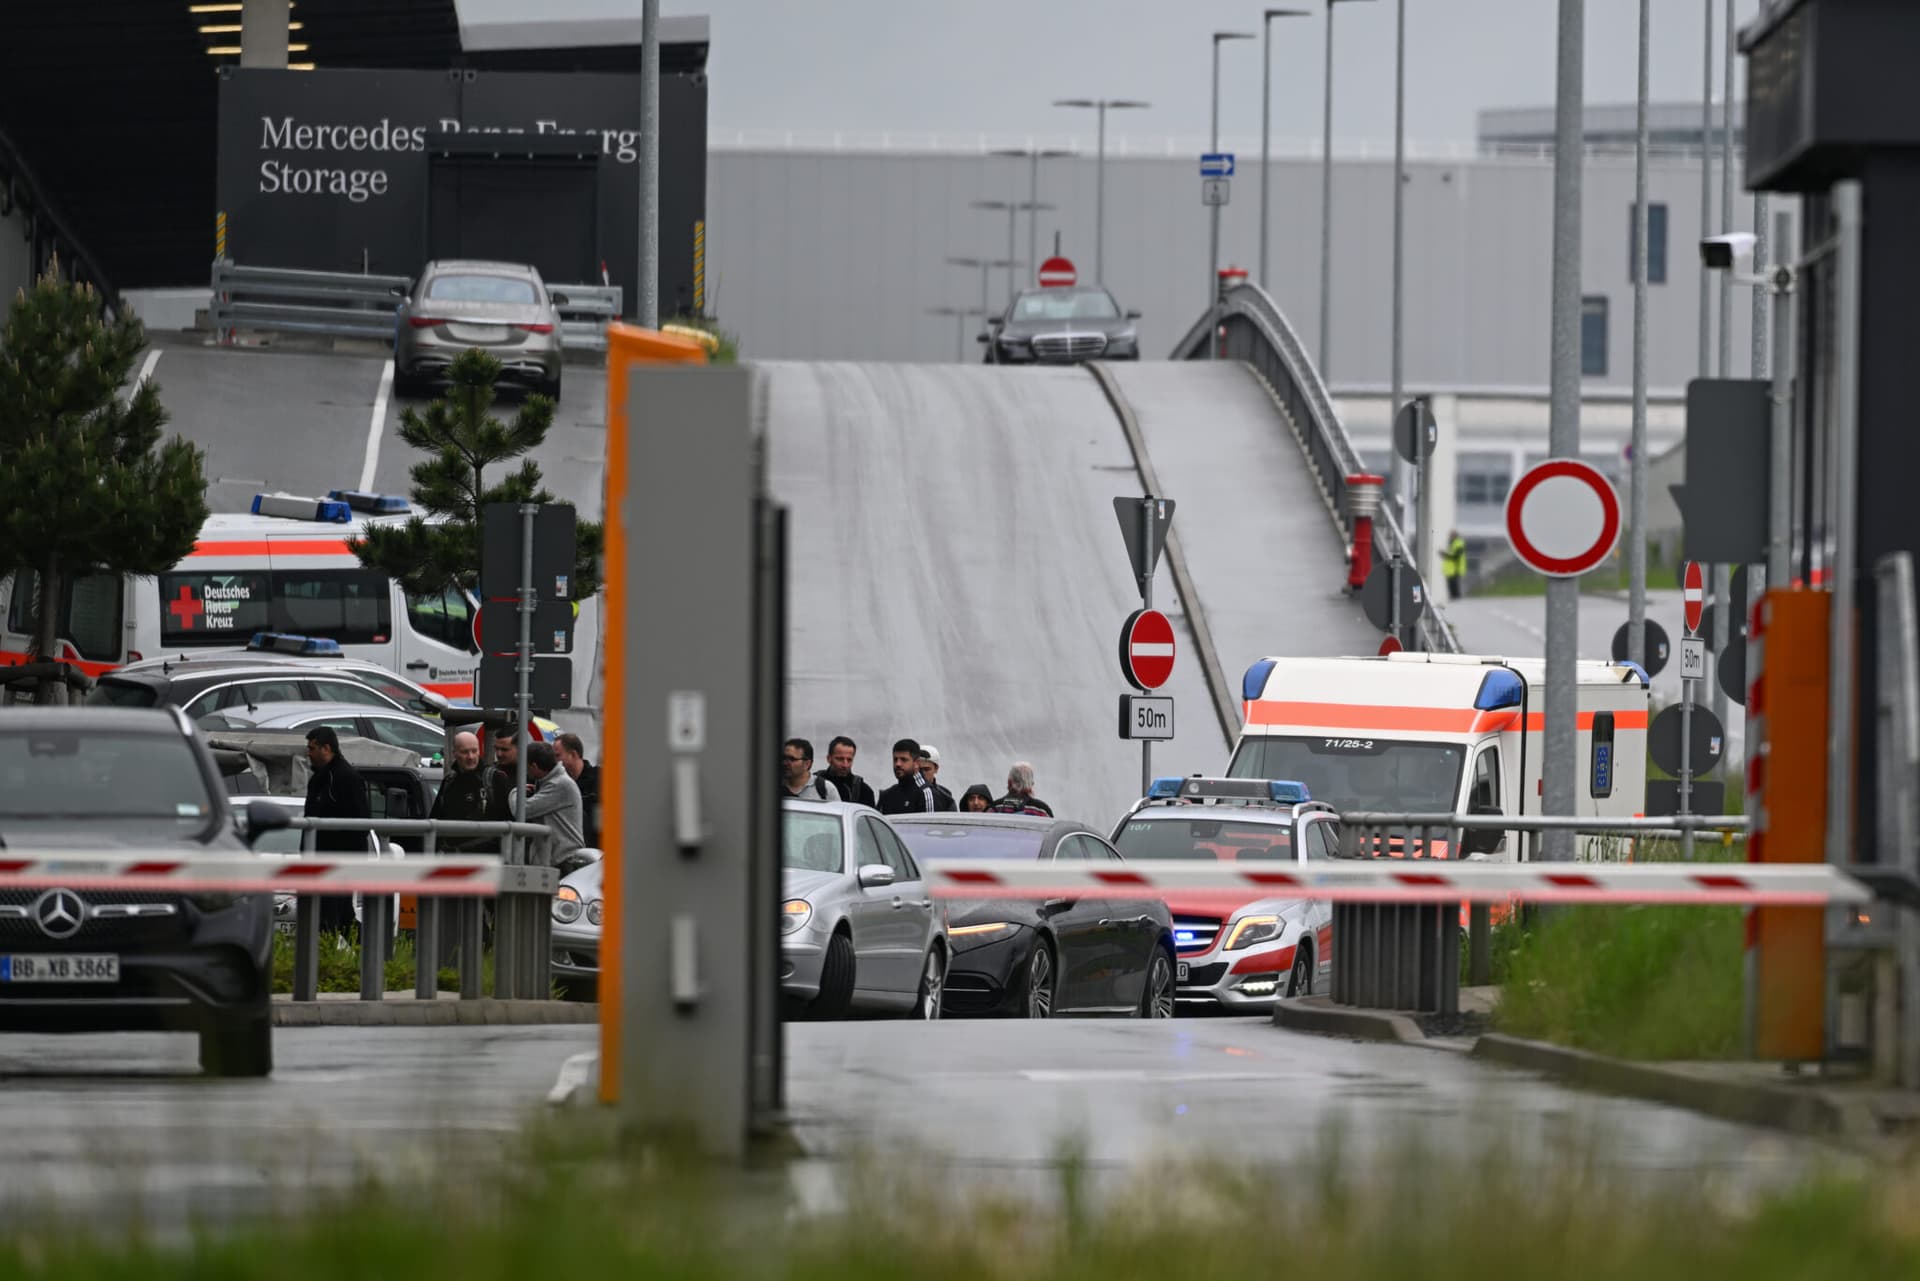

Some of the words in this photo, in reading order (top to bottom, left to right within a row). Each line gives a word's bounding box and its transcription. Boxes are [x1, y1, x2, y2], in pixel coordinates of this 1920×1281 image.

[260, 116, 426, 151] Mercedes
[259, 160, 388, 202] Storage
[204, 584, 250, 599] Deutsches
[206, 615, 234, 629] Kreuz
[1684, 648, 1700, 668] 50m
[1138, 707, 1166, 728] 50m
[1325, 739, 1373, 749] 71/25-2
